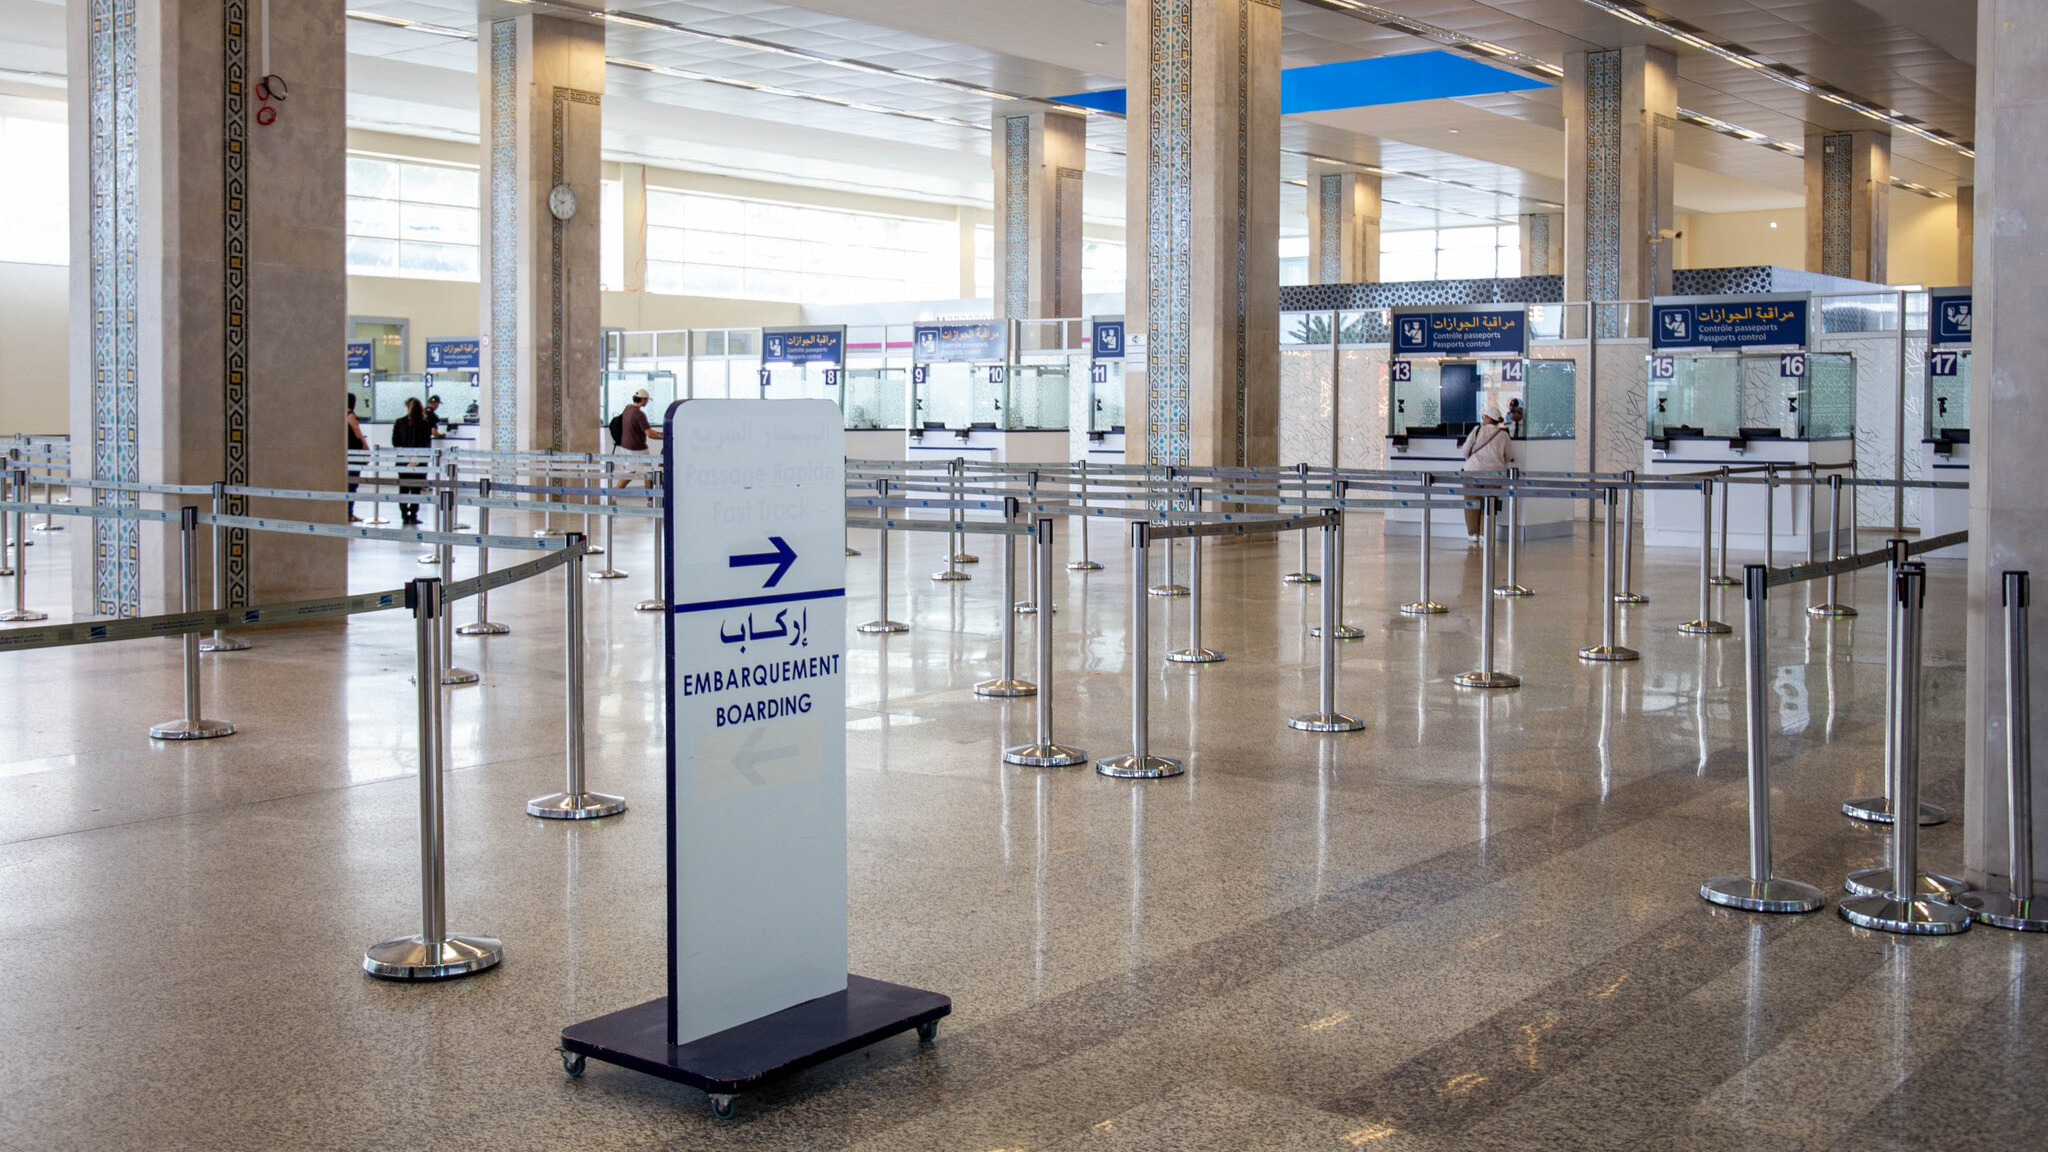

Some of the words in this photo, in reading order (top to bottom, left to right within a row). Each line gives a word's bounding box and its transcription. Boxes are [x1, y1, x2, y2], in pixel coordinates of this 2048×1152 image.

[1698, 307, 1753, 324] الجوازات
[1756, 306, 1795, 323] مراقبة
[1433, 316, 1479, 331] الجوازات
[1483, 315, 1516, 331] مراقبة
[1699, 324, 1733, 333] Contrôle
[1735, 323, 1778, 333] passeports
[1433, 332, 1463, 340] Contrôle
[1463, 331, 1501, 341] passeports
[1699, 334, 1736, 343] Passports
[1737, 333, 1767, 341] control
[1433, 341, 1465, 349] Passports
[1466, 340, 1491, 348] control
[1392, 362, 1410, 380] 13
[1503, 362, 1521, 379] 14
[1652, 359, 1673, 376] 15
[1781, 355, 1804, 376] 16
[1932, 354, 1956, 374] 17
[364, 375, 369, 386] 2
[426, 374, 432, 387] 3
[472, 374, 478, 386] 4
[762, 371, 770, 385] 7
[827, 370, 835, 384] 8
[915, 368, 924, 382] 9
[990, 366, 1003, 382] 10
[1092, 365, 1105, 382] 11
[686, 464, 767, 489] Passage
[774, 459, 836, 485] Rapide
[712, 500, 752, 525] Fast
[758, 497, 809, 521] Track
[684, 654, 839, 696] EMBARQUEMENT
[716, 693, 812, 727] BOARDING
